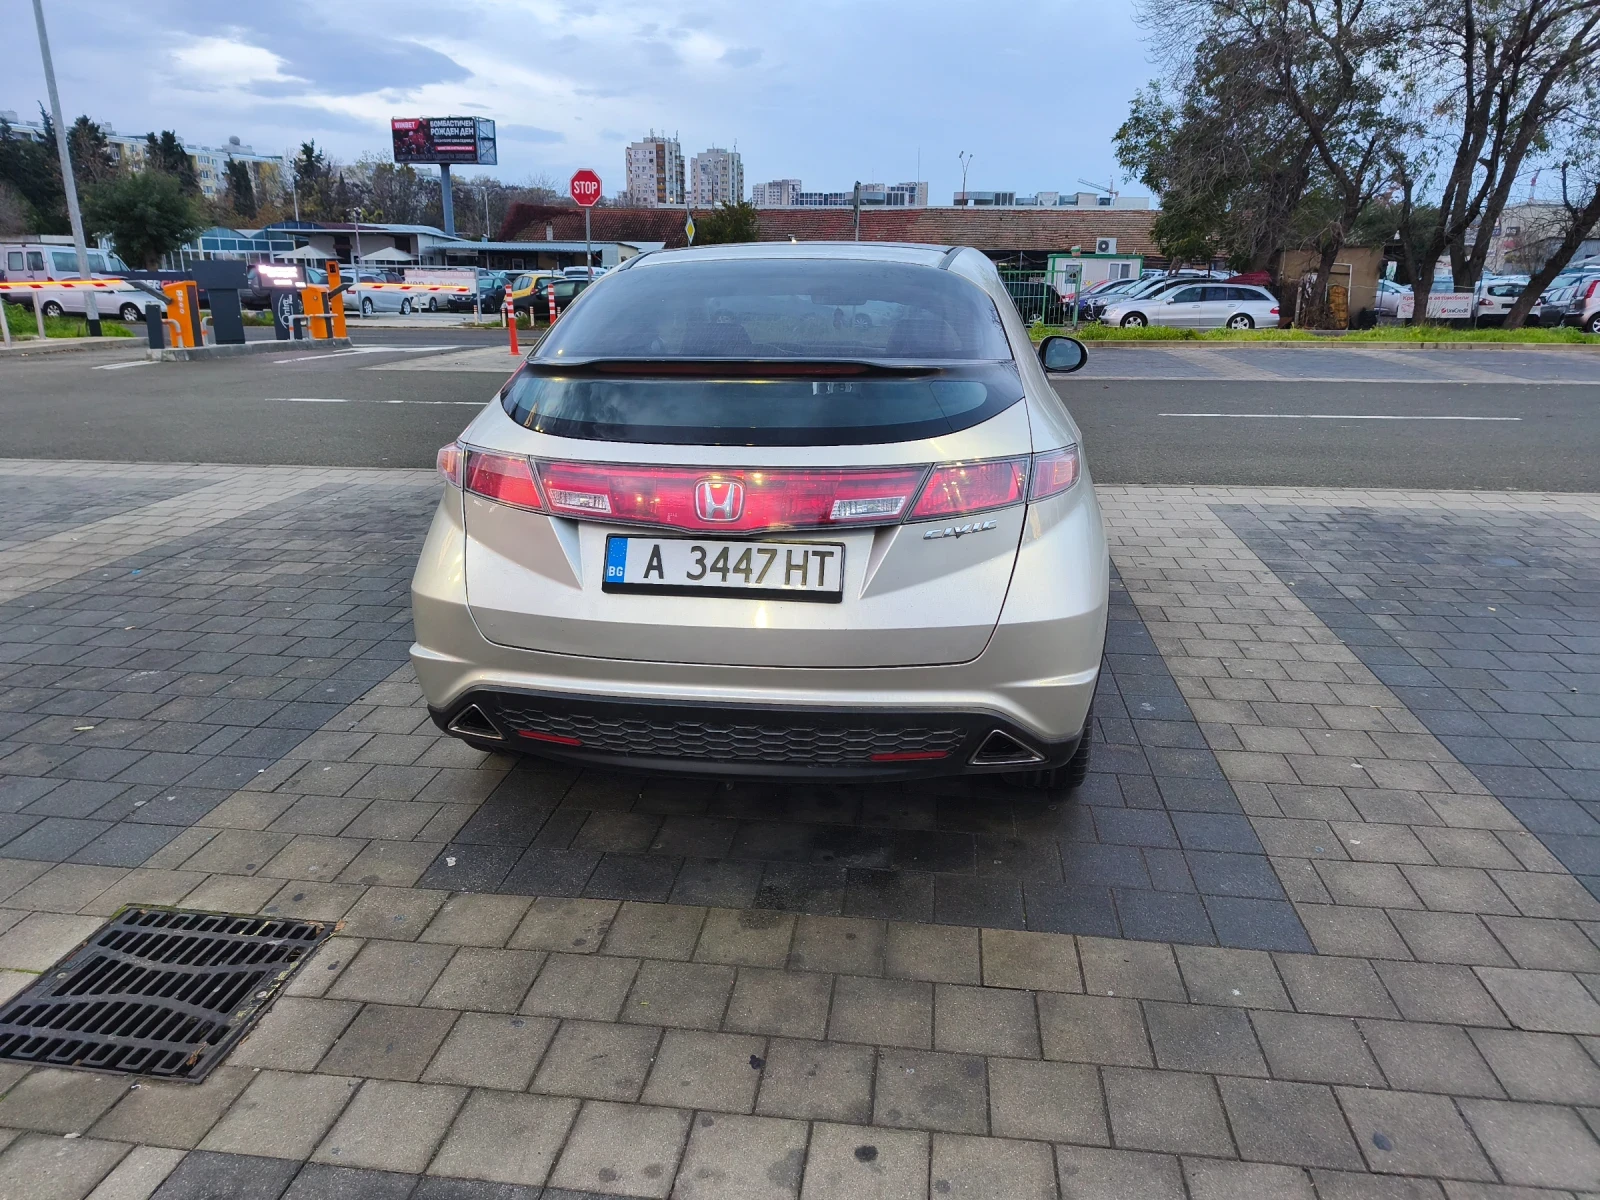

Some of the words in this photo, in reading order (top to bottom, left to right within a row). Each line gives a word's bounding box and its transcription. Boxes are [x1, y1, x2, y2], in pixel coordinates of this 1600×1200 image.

[430, 128, 459, 136] РОЖДЕН
[460, 128, 474, 136] ДЕН
[574, 181, 598, 195] STOP
[923, 519, 997, 540] CIVIC
[608, 565, 624, 577] BG
[643, 544, 664, 579] A
[686, 545, 778, 584] 3447
[784, 549, 835, 587] HT
